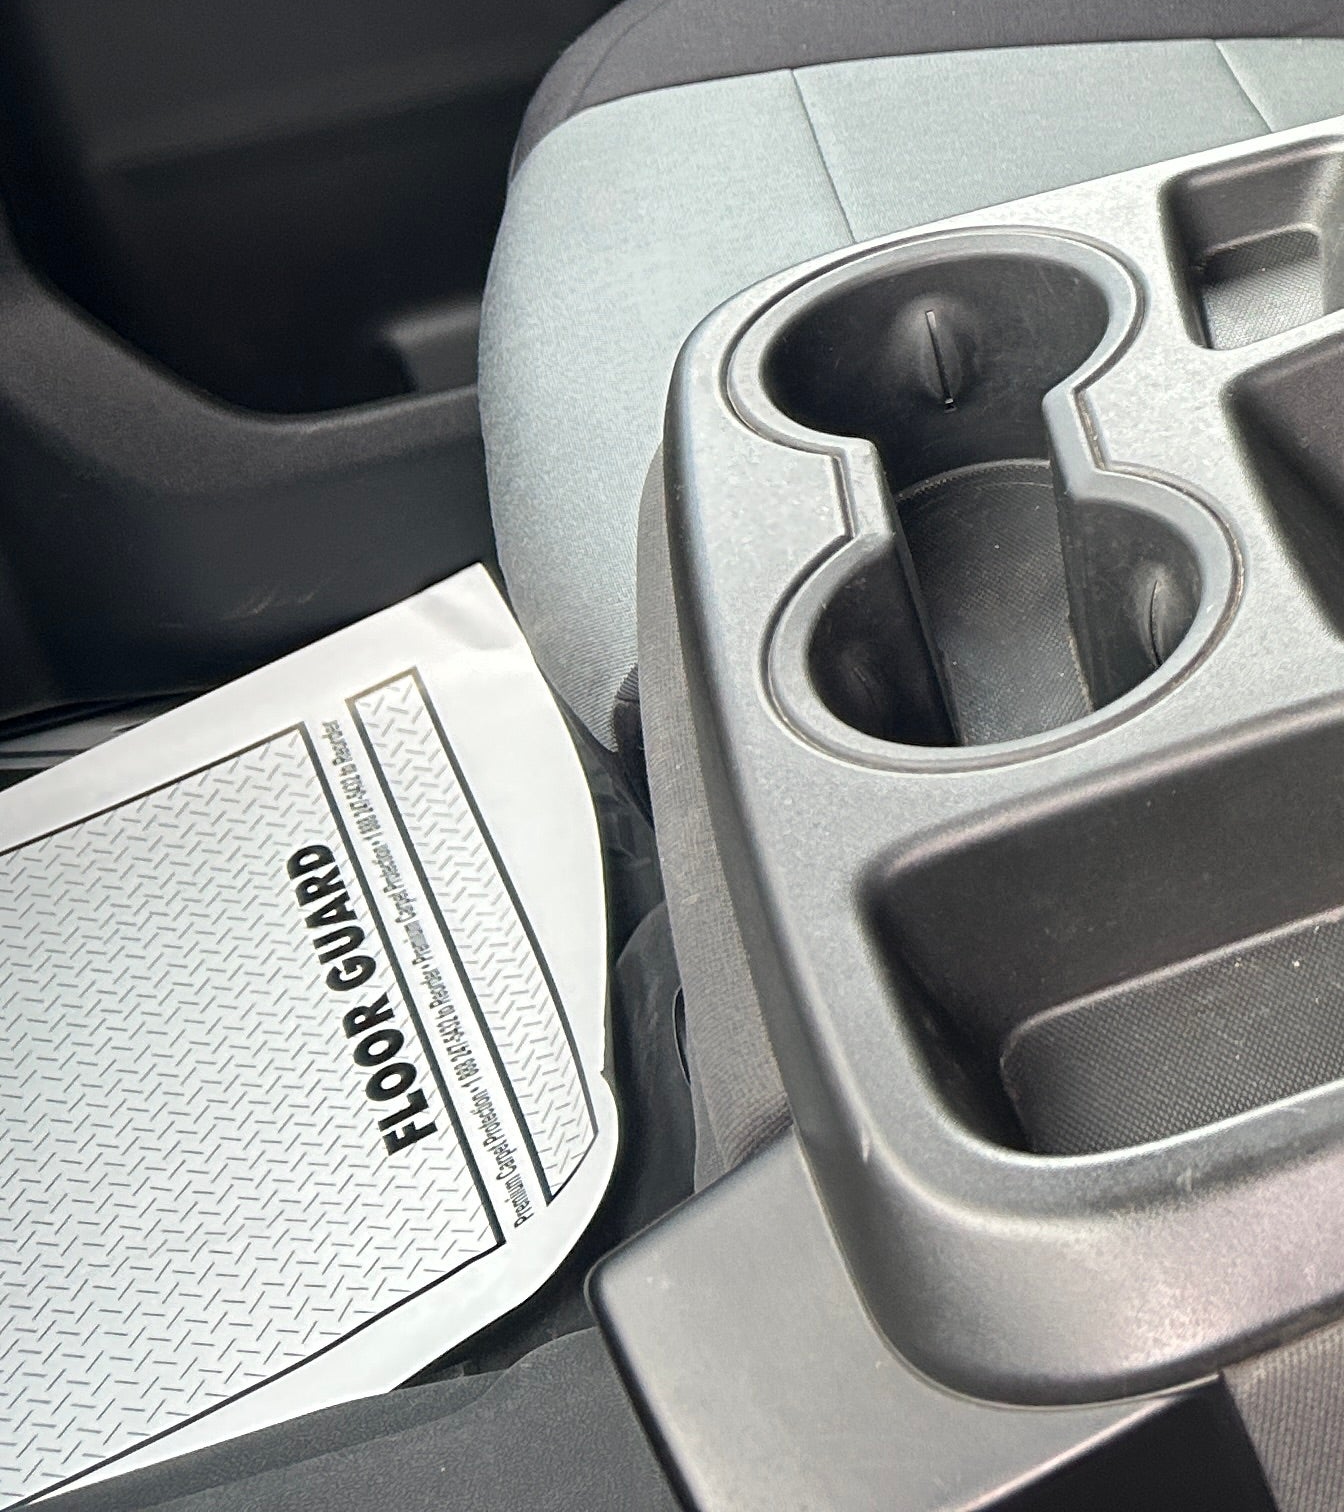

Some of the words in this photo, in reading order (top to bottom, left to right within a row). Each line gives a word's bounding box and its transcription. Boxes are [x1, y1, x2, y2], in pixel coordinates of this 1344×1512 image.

[286, 844, 377, 992] GUARD
[421, 968, 450, 1010] Reorder
[436, 1015, 473, 1063] 247-5432
[342, 991, 439, 1157] FLOOR
[453, 1057, 480, 1082] 888
[470, 1088, 505, 1148] Protection
[487, 1139, 518, 1181] Carpet
[504, 1173, 535, 1229] Premium
